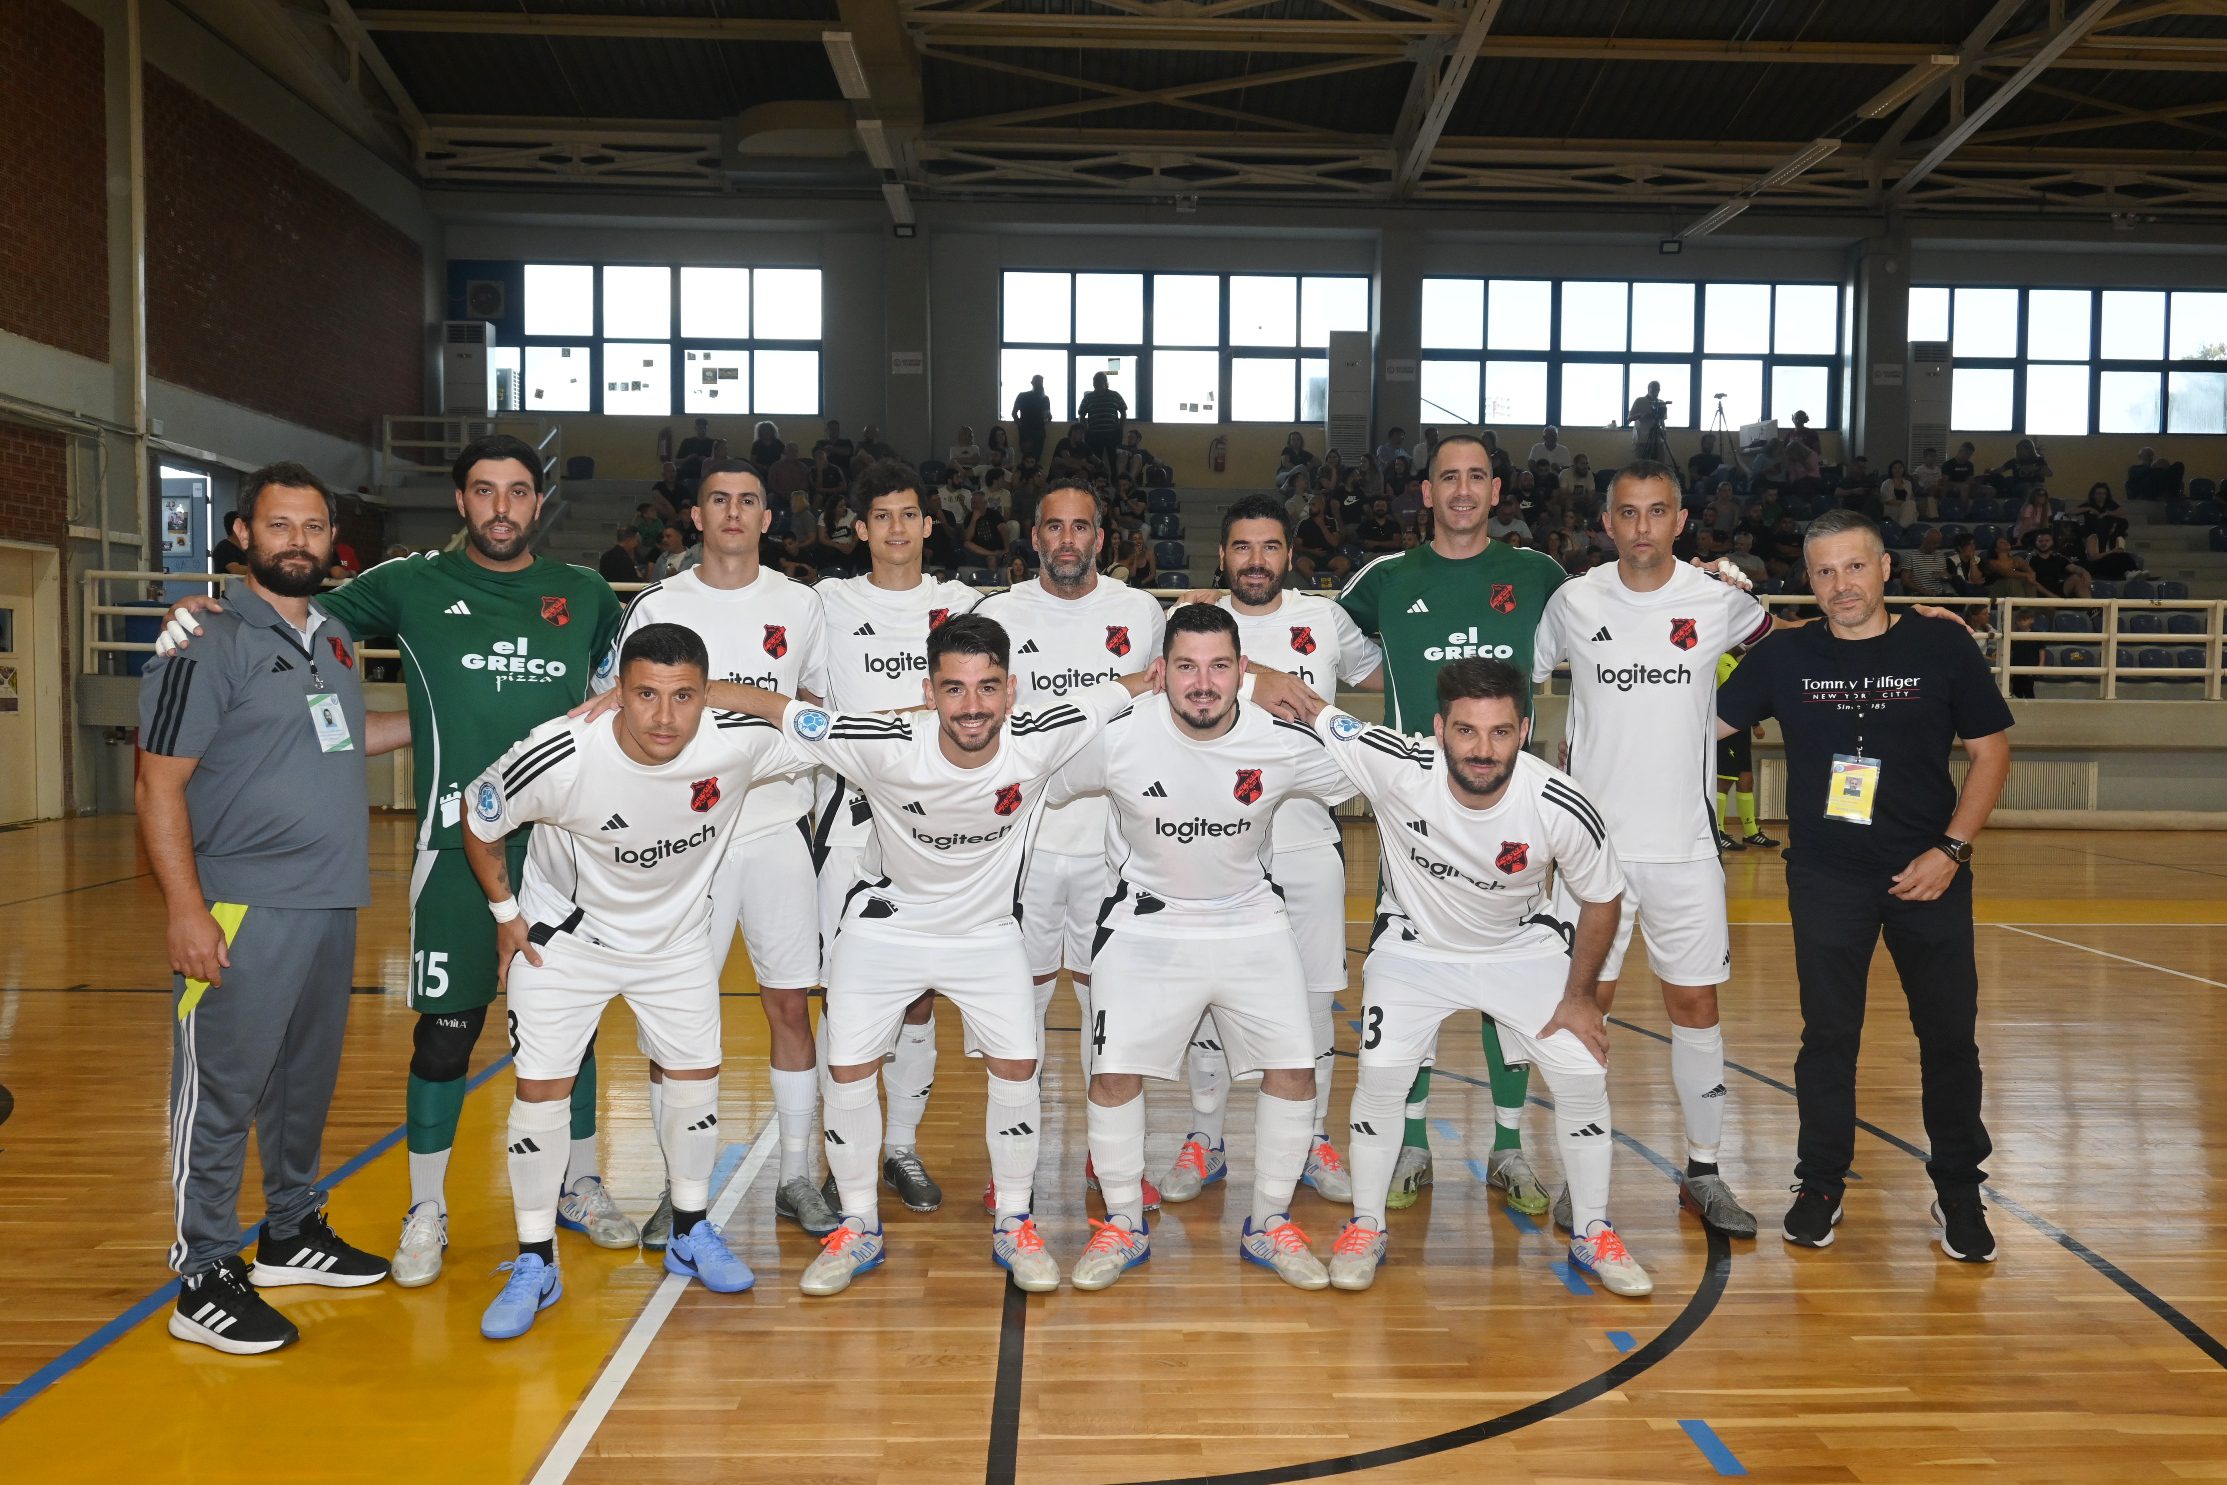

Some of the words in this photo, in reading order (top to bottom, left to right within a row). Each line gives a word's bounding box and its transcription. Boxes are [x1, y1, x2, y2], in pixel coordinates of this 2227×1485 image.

[492, 636, 528, 656] el
[1448, 626, 1478, 645] el
[461, 653, 567, 677] GRECO
[864, 651, 928, 680] logite
[1423, 644, 1514, 661] GRECO
[496, 672, 553, 693] pizza
[1596, 662, 1692, 692] logitech
[1882, 691, 1909, 699] CITY
[912, 824, 1012, 850] logitech
[1156, 817, 1252, 844] logitech
[615, 824, 716, 869] logitech
[1410, 847, 1506, 890] logich
[414, 949, 449, 998] 15
